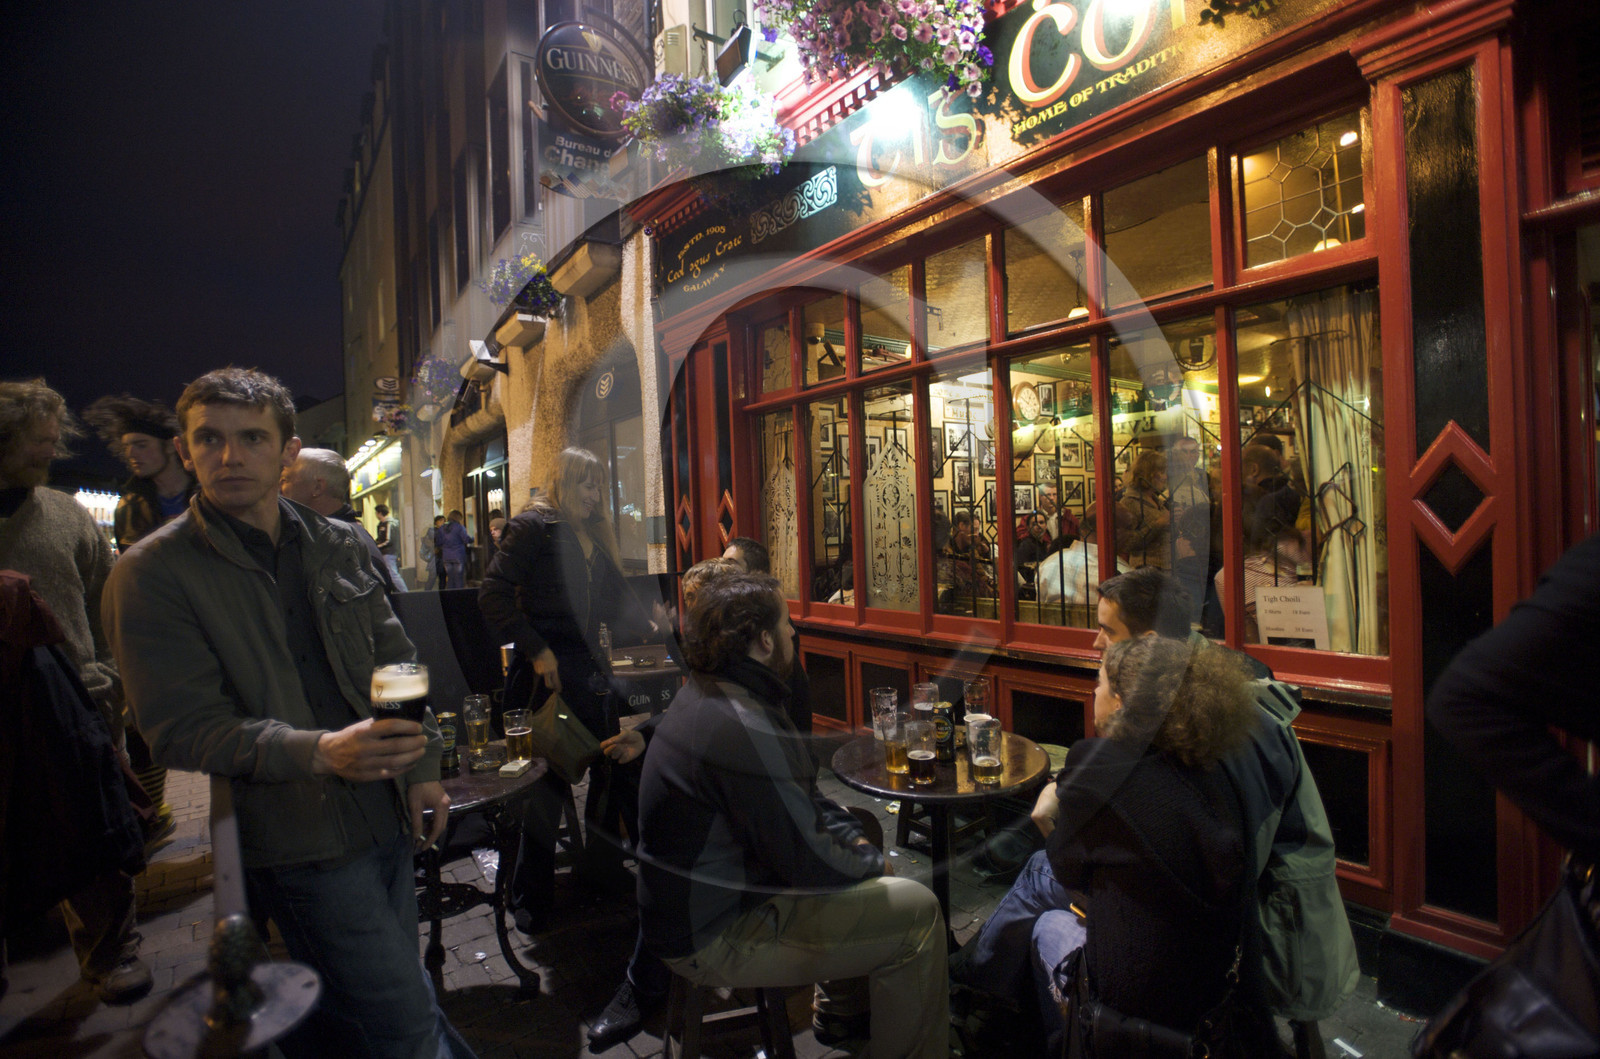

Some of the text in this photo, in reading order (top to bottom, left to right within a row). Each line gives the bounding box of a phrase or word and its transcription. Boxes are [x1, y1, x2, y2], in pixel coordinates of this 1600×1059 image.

[546, 47, 639, 89] GUINNESS
[1013, 100, 1068, 135] HOME
[1069, 86, 1097, 108] OF
[555, 135, 601, 155] Bureau
[705, 225, 726, 237] 1905
[689, 253, 711, 279] agus
[683, 264, 726, 292] GALWAY
[1263, 596, 1278, 604] Tigh
[628, 689, 671, 707] GUINSS
